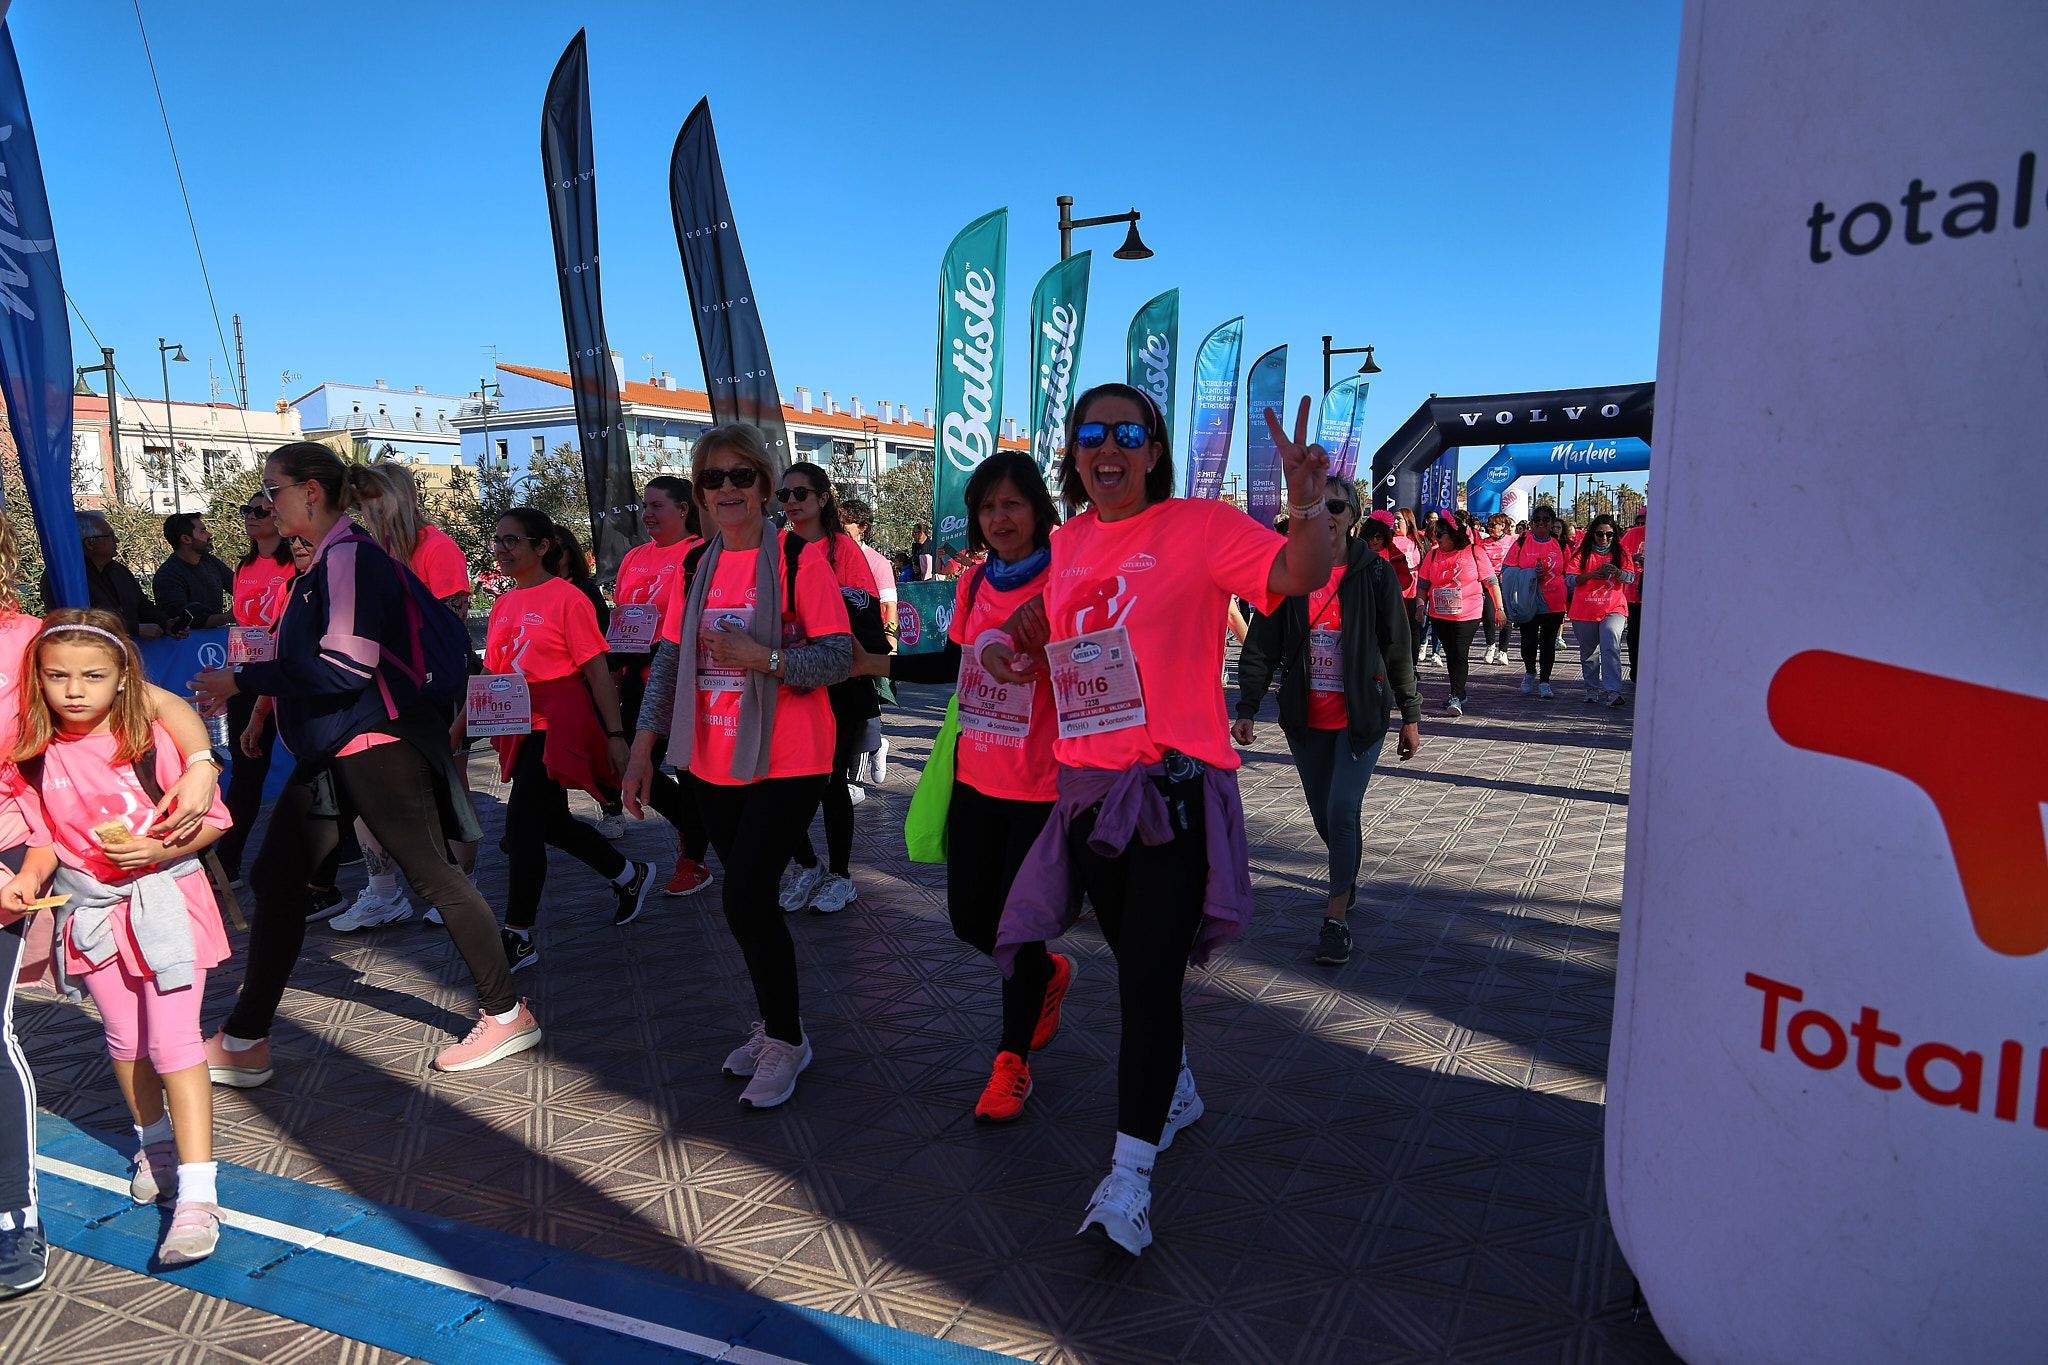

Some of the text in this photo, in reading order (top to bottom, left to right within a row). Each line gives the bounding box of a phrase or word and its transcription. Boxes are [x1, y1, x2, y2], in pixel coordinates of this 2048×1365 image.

[1807, 151, 2048, 263] total
[716, 369, 767, 385] VOLVO
[1460, 403, 1620, 426] VOLVO
[1550, 443, 1617, 470] Marlene
[246, 647, 264, 655] 016
[978, 684, 1008, 701] 016
[1077, 676, 1109, 696] 016
[491, 701, 512, 711] 016
[993, 722, 1020, 732] Santander
[1104, 715, 1134, 726] Santander
[975, 730, 983, 742] DE
[985, 733, 994, 743] LA
[996, 734, 1024, 749] MUJER
